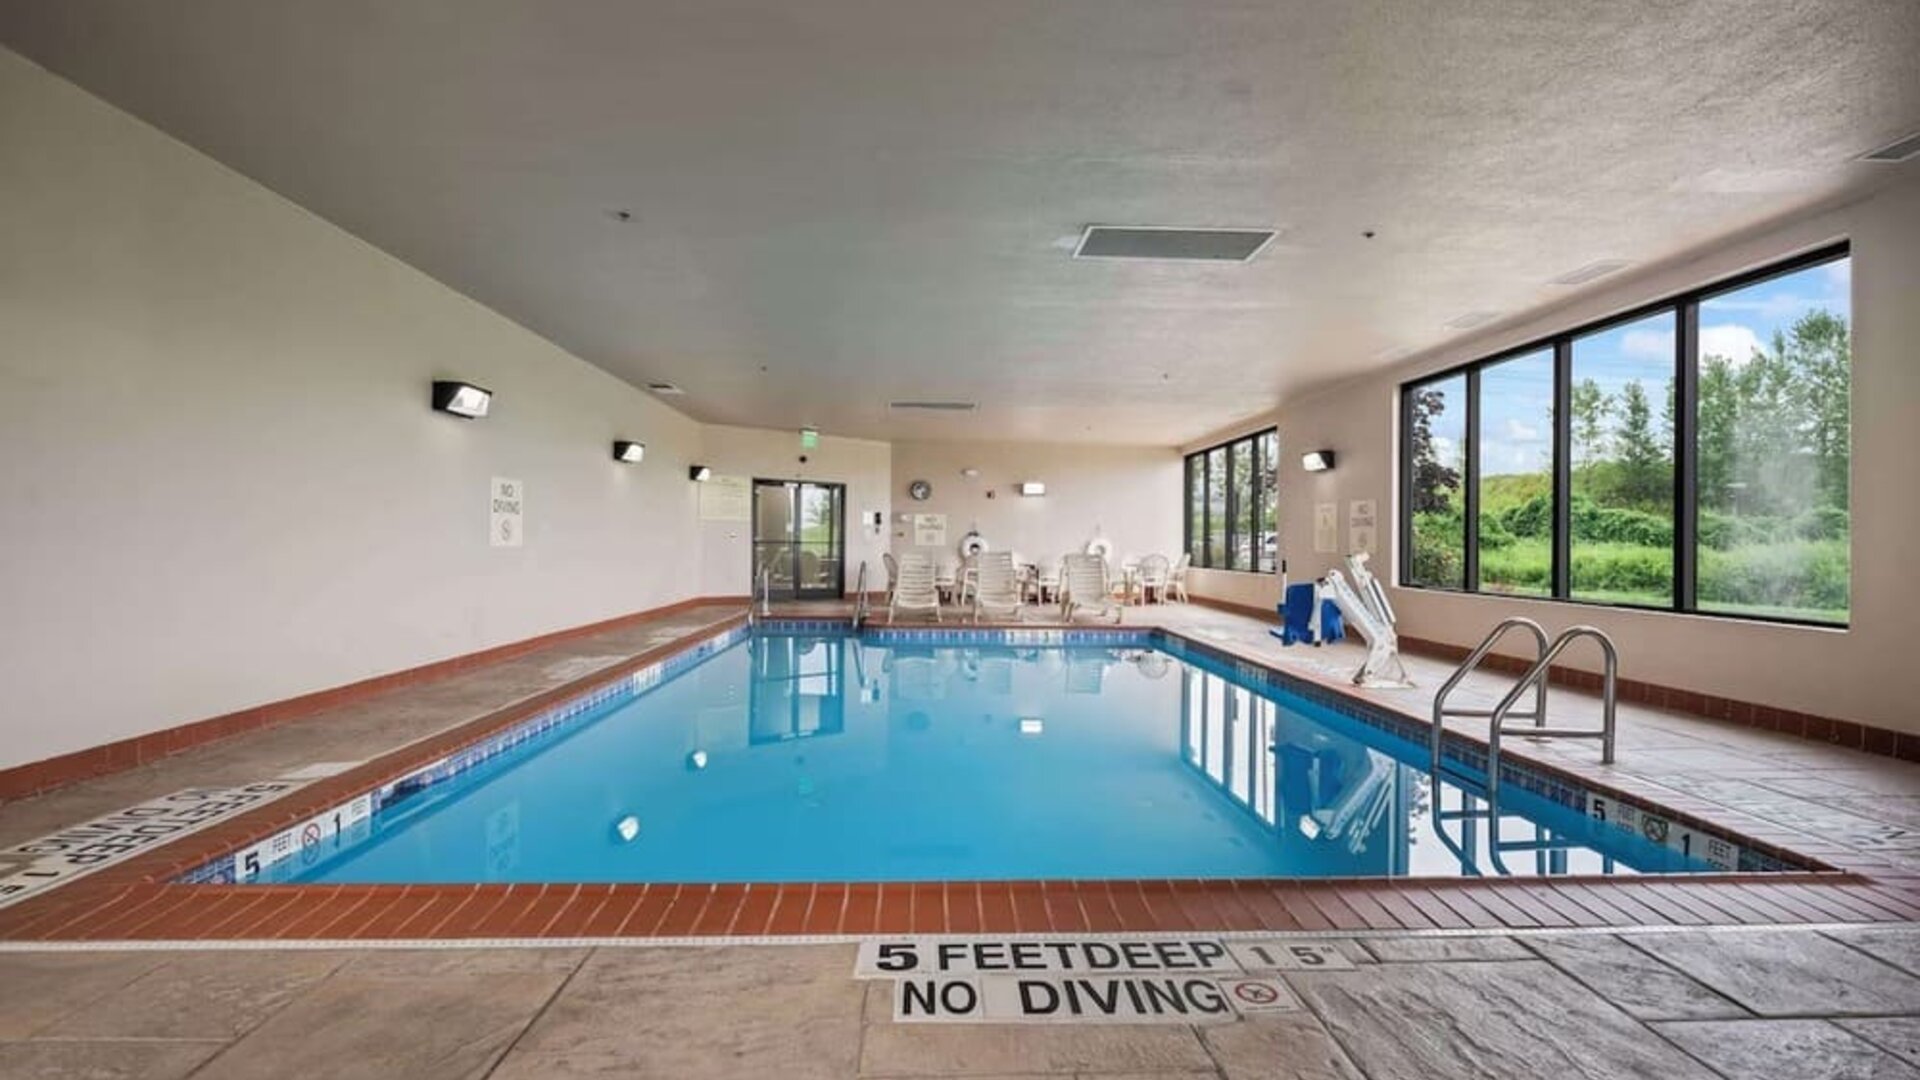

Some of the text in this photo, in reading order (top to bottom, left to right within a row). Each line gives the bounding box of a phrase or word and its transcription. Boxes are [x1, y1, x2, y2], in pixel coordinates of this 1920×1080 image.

[501, 483, 514, 498] NO
[493, 499, 520, 515] DIVING
[1593, 799, 1606, 821] 5
[1681, 833, 1691, 857] 1
[245, 852, 260, 876] 5
[333, 812, 341, 835] 1
[876, 944, 919, 971] 5
[1250, 946, 1276, 966] 1
[902, 979, 1230, 1015] NO DIVING
